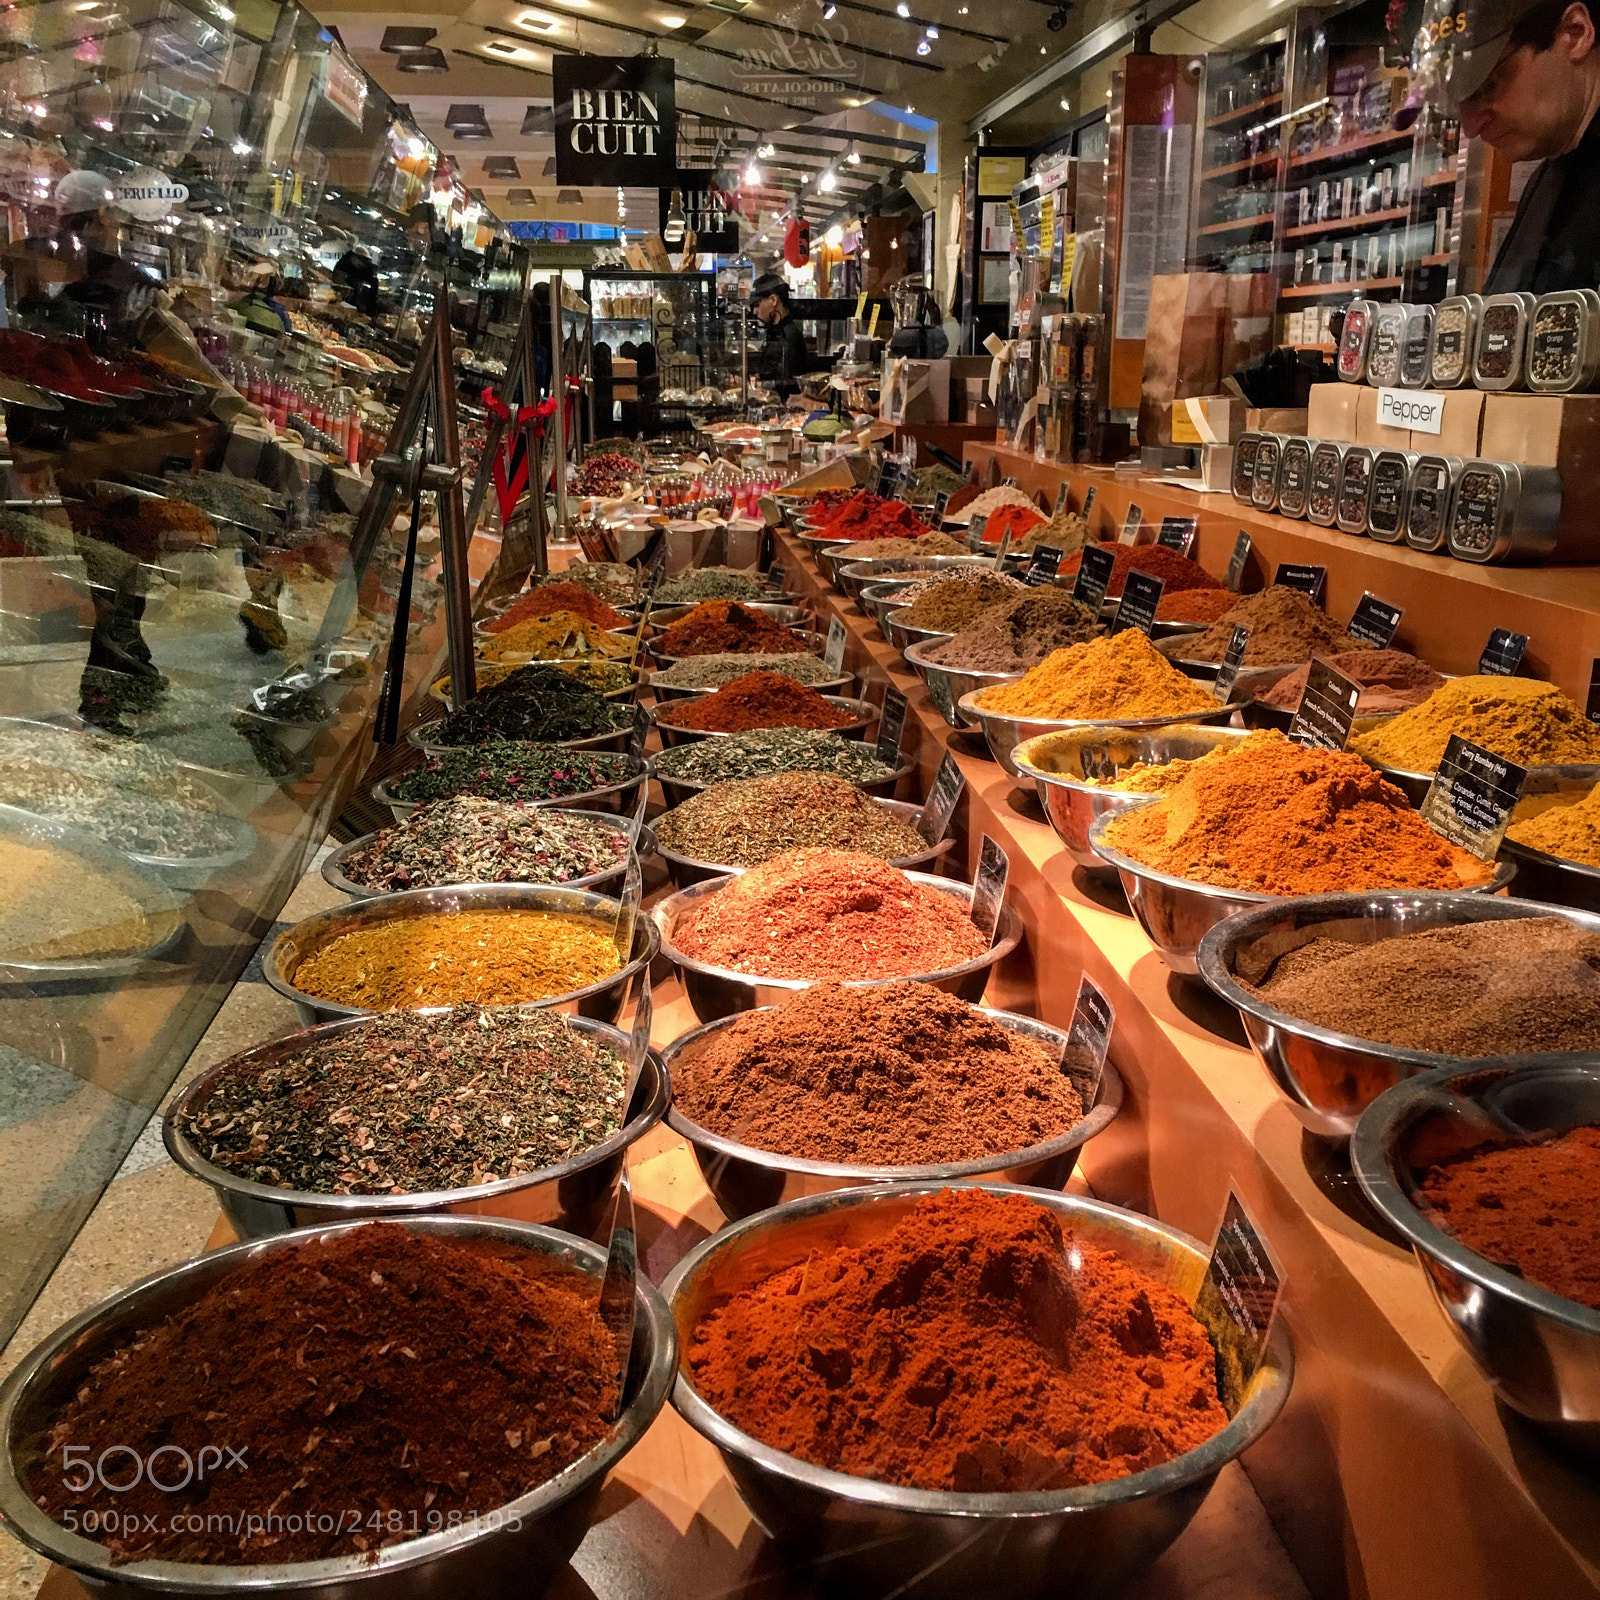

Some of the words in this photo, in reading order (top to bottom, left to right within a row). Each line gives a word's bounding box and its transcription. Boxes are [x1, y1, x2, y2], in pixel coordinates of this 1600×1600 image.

[570, 88, 660, 122] BIEN
[570, 123, 661, 156] CUIT
[681, 190, 727, 210] IEN
[685, 212, 727, 233] UIT
[1546, 335, 1564, 344] Orange
[1382, 393, 1437, 424] Pepper
[1316, 706, 1326, 719] Curry
[1461, 746, 1475, 760] Curry
[1474, 753, 1496, 772] Bombay
[1494, 763, 1507, 777] (Hot)
[1453, 782, 1477, 801] Coriander,
[1476, 794, 1492, 810] Cumin,
[1456, 796, 1473, 813] Fennel,
[1473, 805, 1497, 825] Cinnamon
